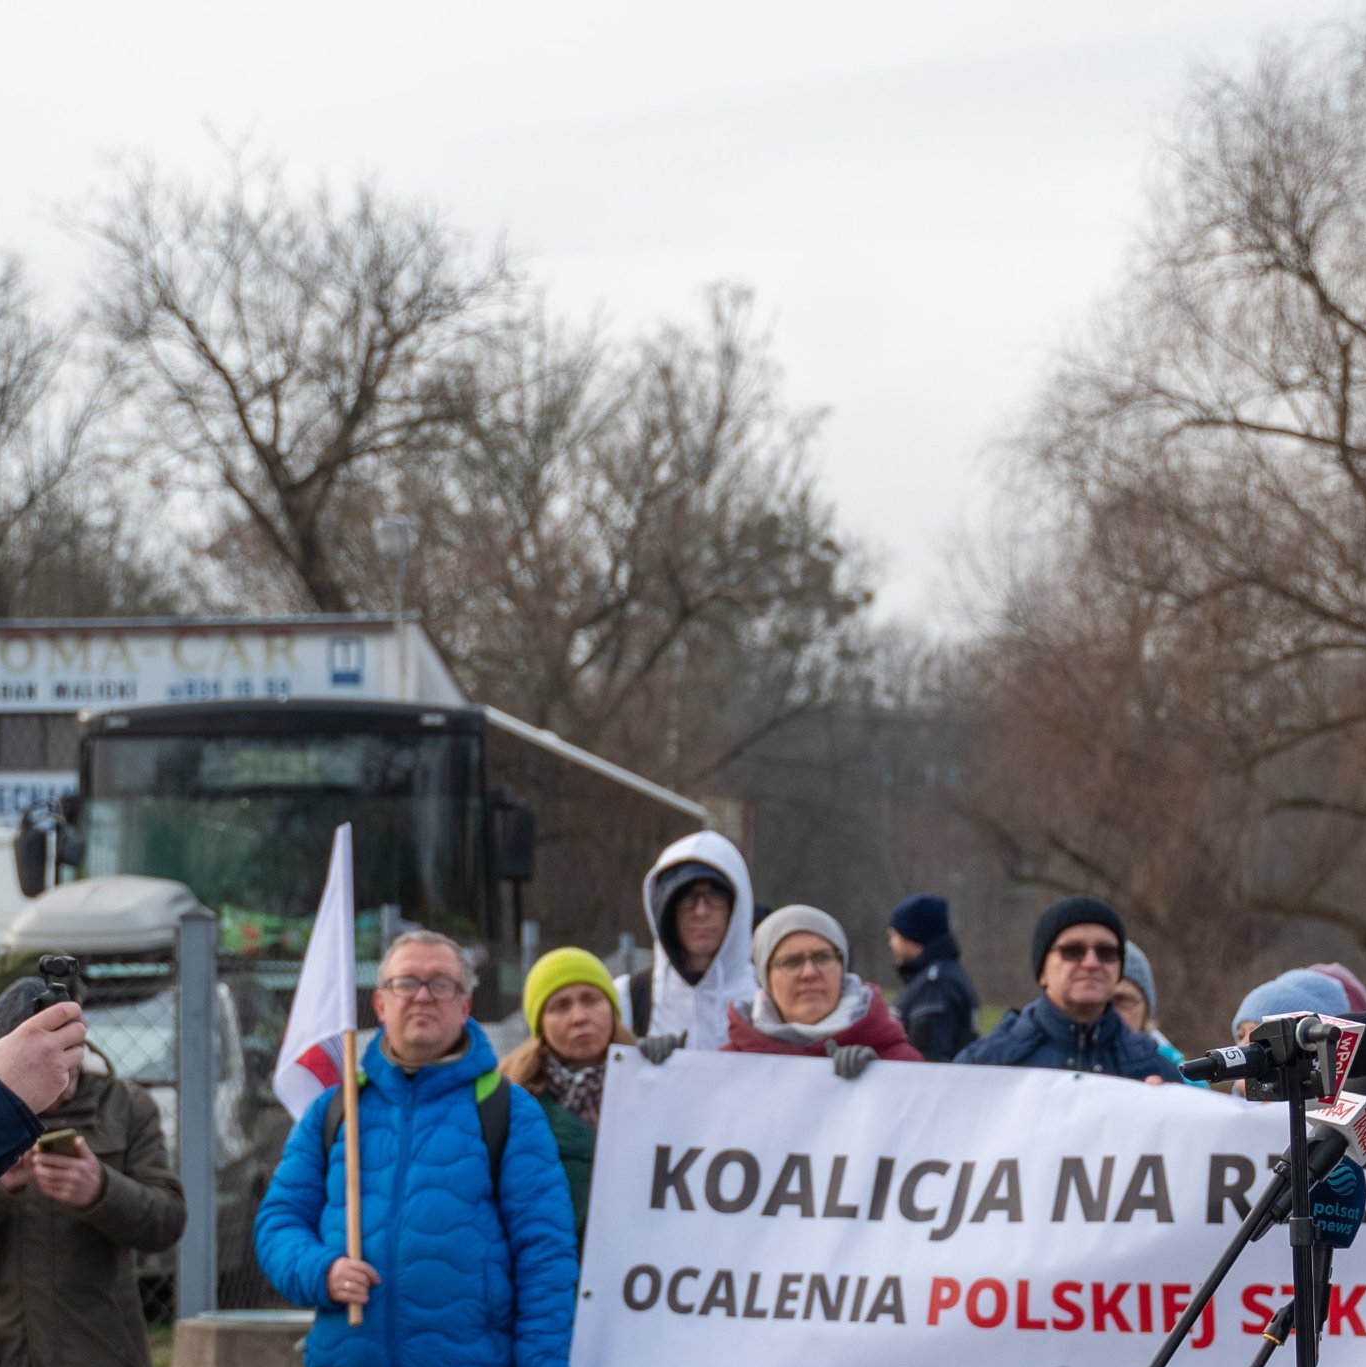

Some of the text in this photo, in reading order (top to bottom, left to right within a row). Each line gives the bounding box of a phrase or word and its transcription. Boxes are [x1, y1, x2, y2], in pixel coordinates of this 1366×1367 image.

[648, 1143, 1025, 1242] KOALICJA
[1050, 1154, 1175, 1224] NA
[1313, 1202, 1361, 1220] polsat
[1317, 1219, 1353, 1235] news
[622, 1263, 907, 1325] OCALENIA
[926, 1276, 1218, 1349] POLSKIEJ
